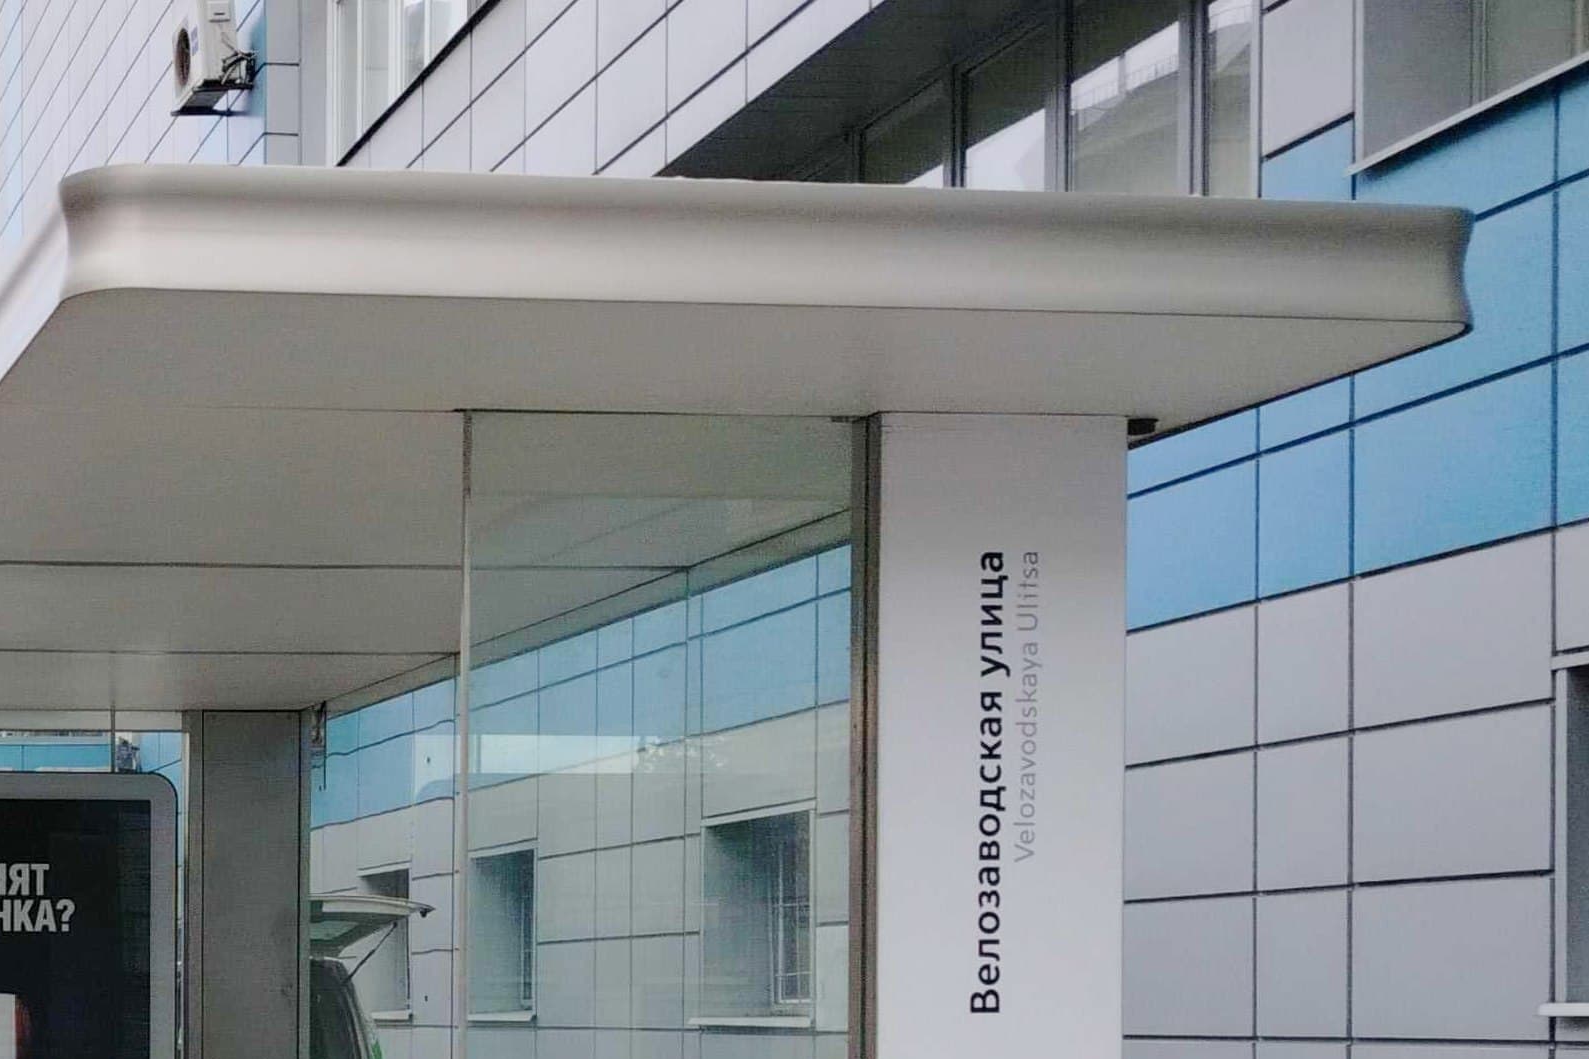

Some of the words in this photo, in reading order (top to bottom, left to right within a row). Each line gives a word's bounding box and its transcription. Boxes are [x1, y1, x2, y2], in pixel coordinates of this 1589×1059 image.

[980, 551, 1011, 678] улица
[1016, 551, 1039, 631] Ulitsa
[1014, 642, 1042, 863] Velozavodskaya
[970, 691, 1007, 1014] Велозаводская
